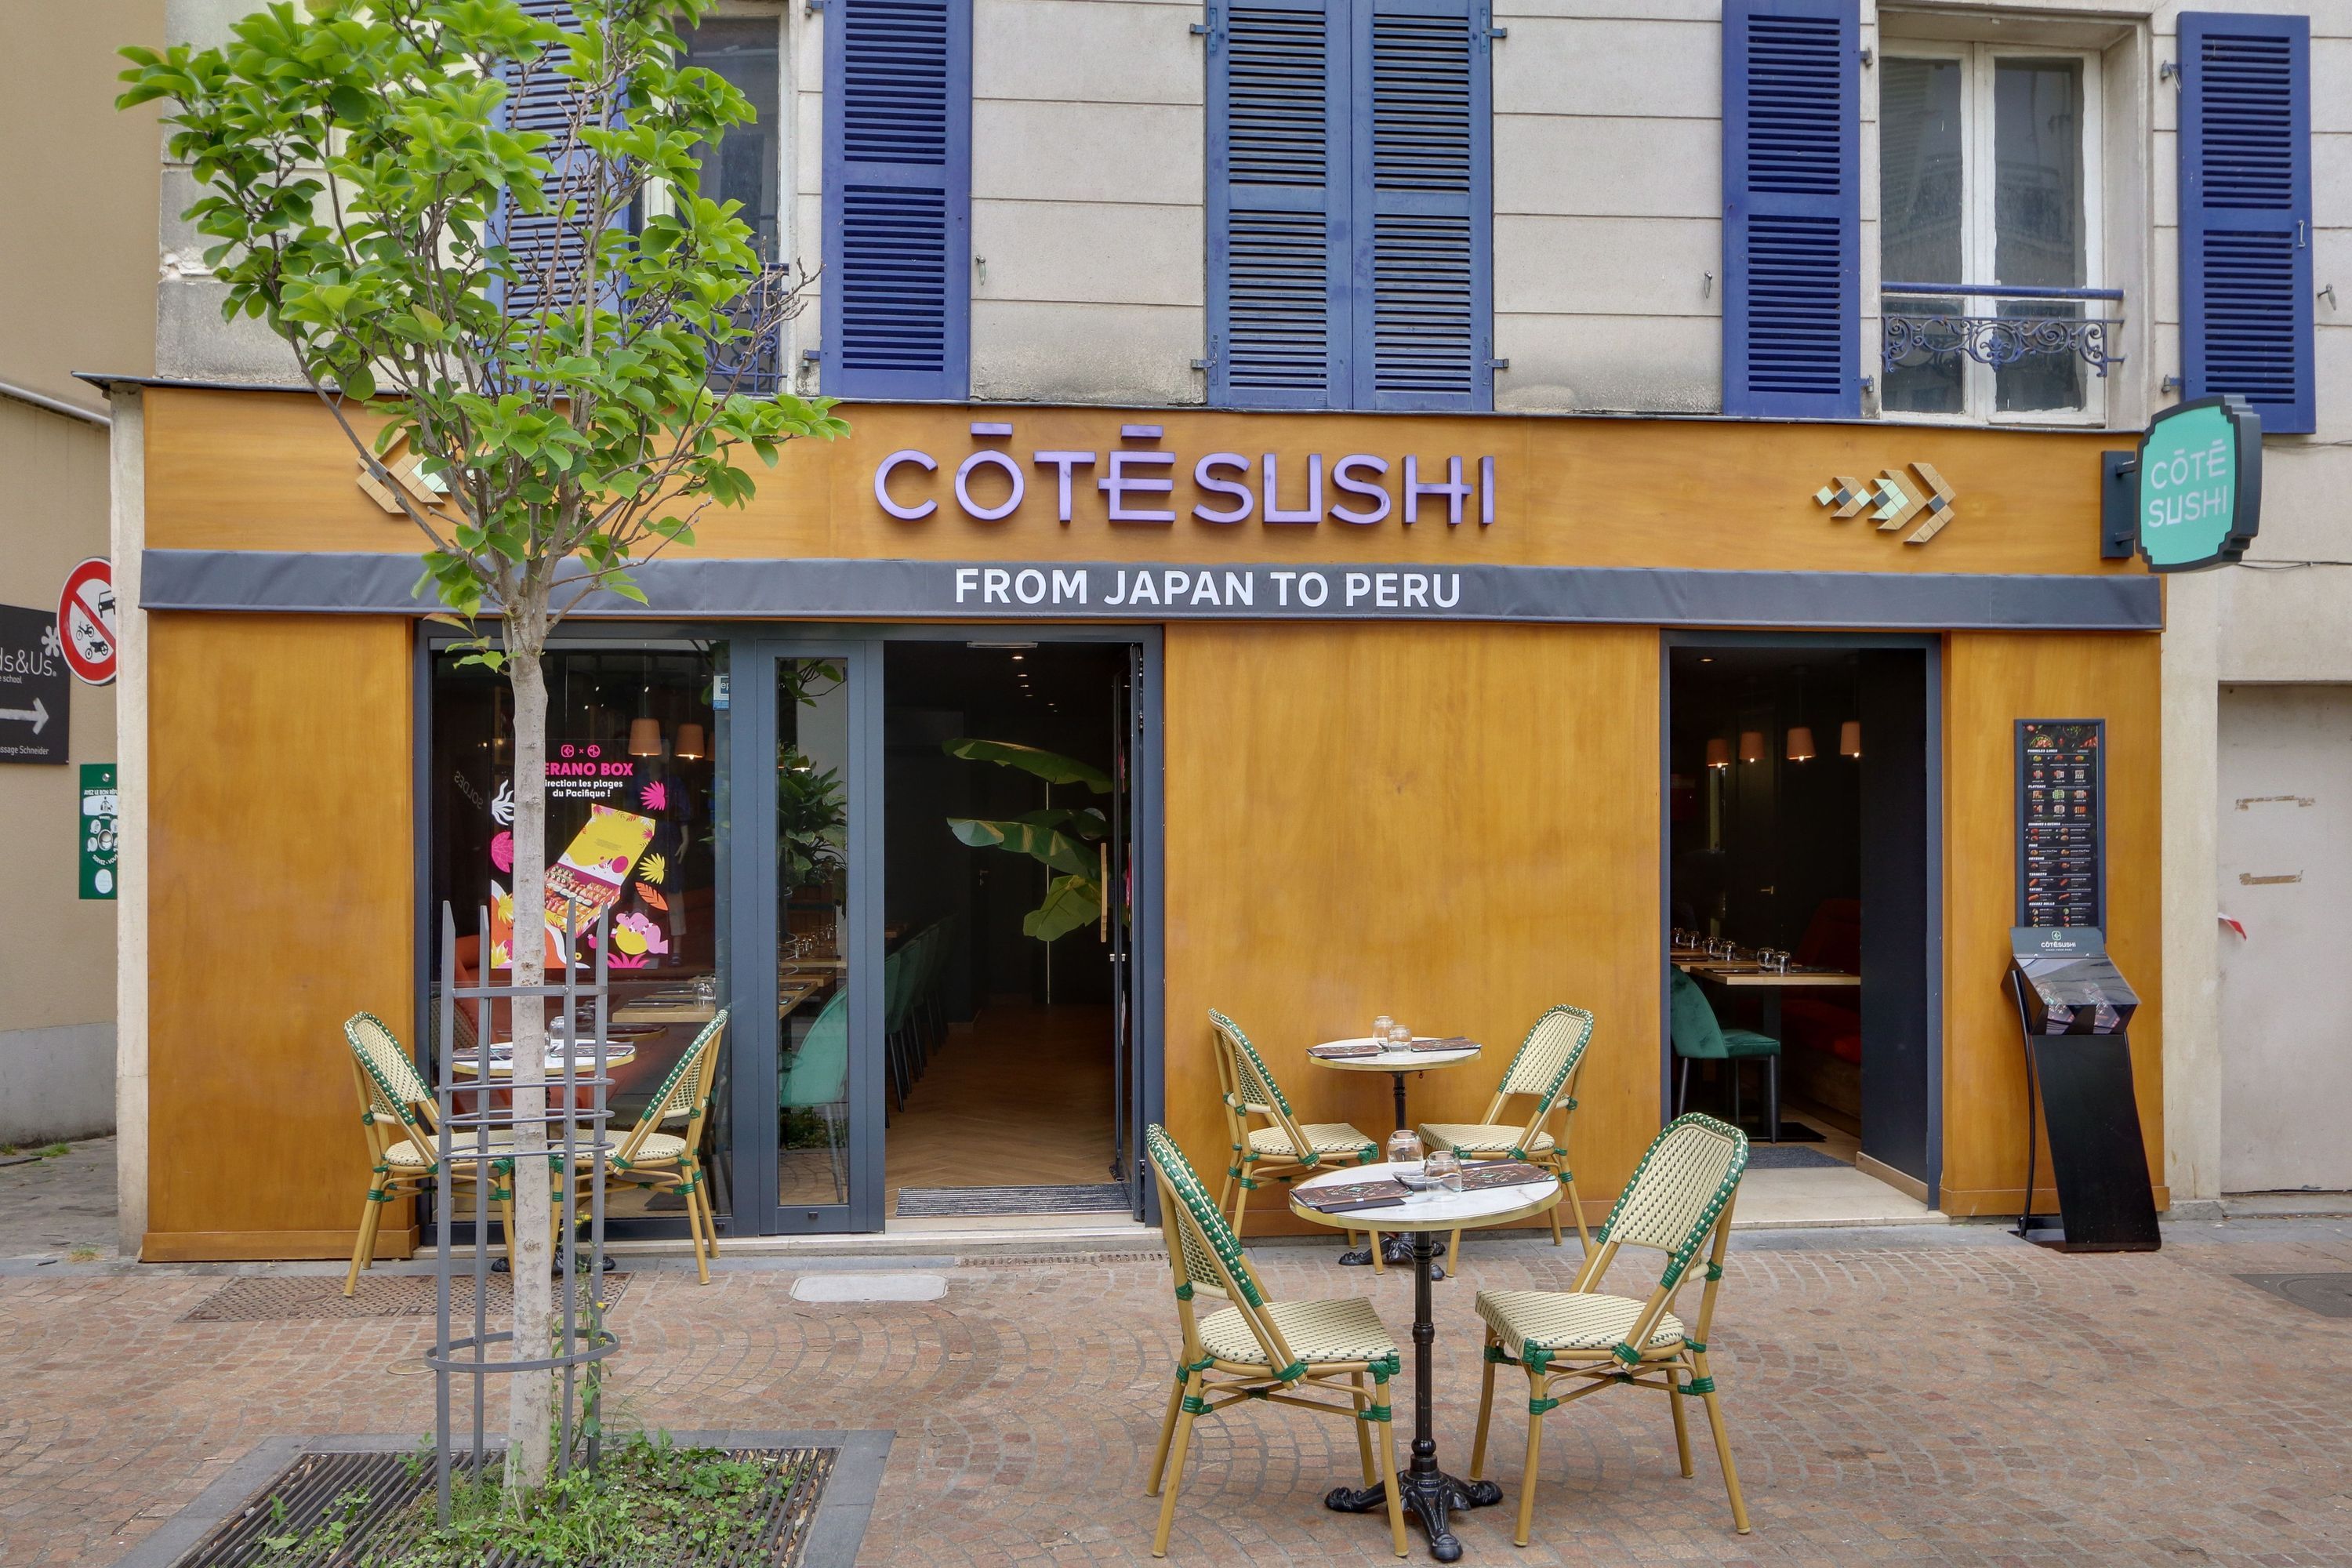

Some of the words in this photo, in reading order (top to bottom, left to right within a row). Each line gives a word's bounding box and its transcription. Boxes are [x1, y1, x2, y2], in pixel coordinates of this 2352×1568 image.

[2148, 485, 2227, 528] SUSHI
[956, 568, 1087, 604] FROM
[1104, 570, 1253, 606] JAPAN
[1270, 572, 1329, 607] TO
[1345, 573, 1460, 608] PERU
[3, 674, 22, 684] school
[0, 746, 18, 756] ssage
[19, 745, 49, 755] Schneider
[601, 762, 633, 775] BOX
[593, 779, 623, 789] plages
[553, 789, 564, 797] du
[565, 789, 605, 799] Pacifique
[608, 789, 611, 797] !
